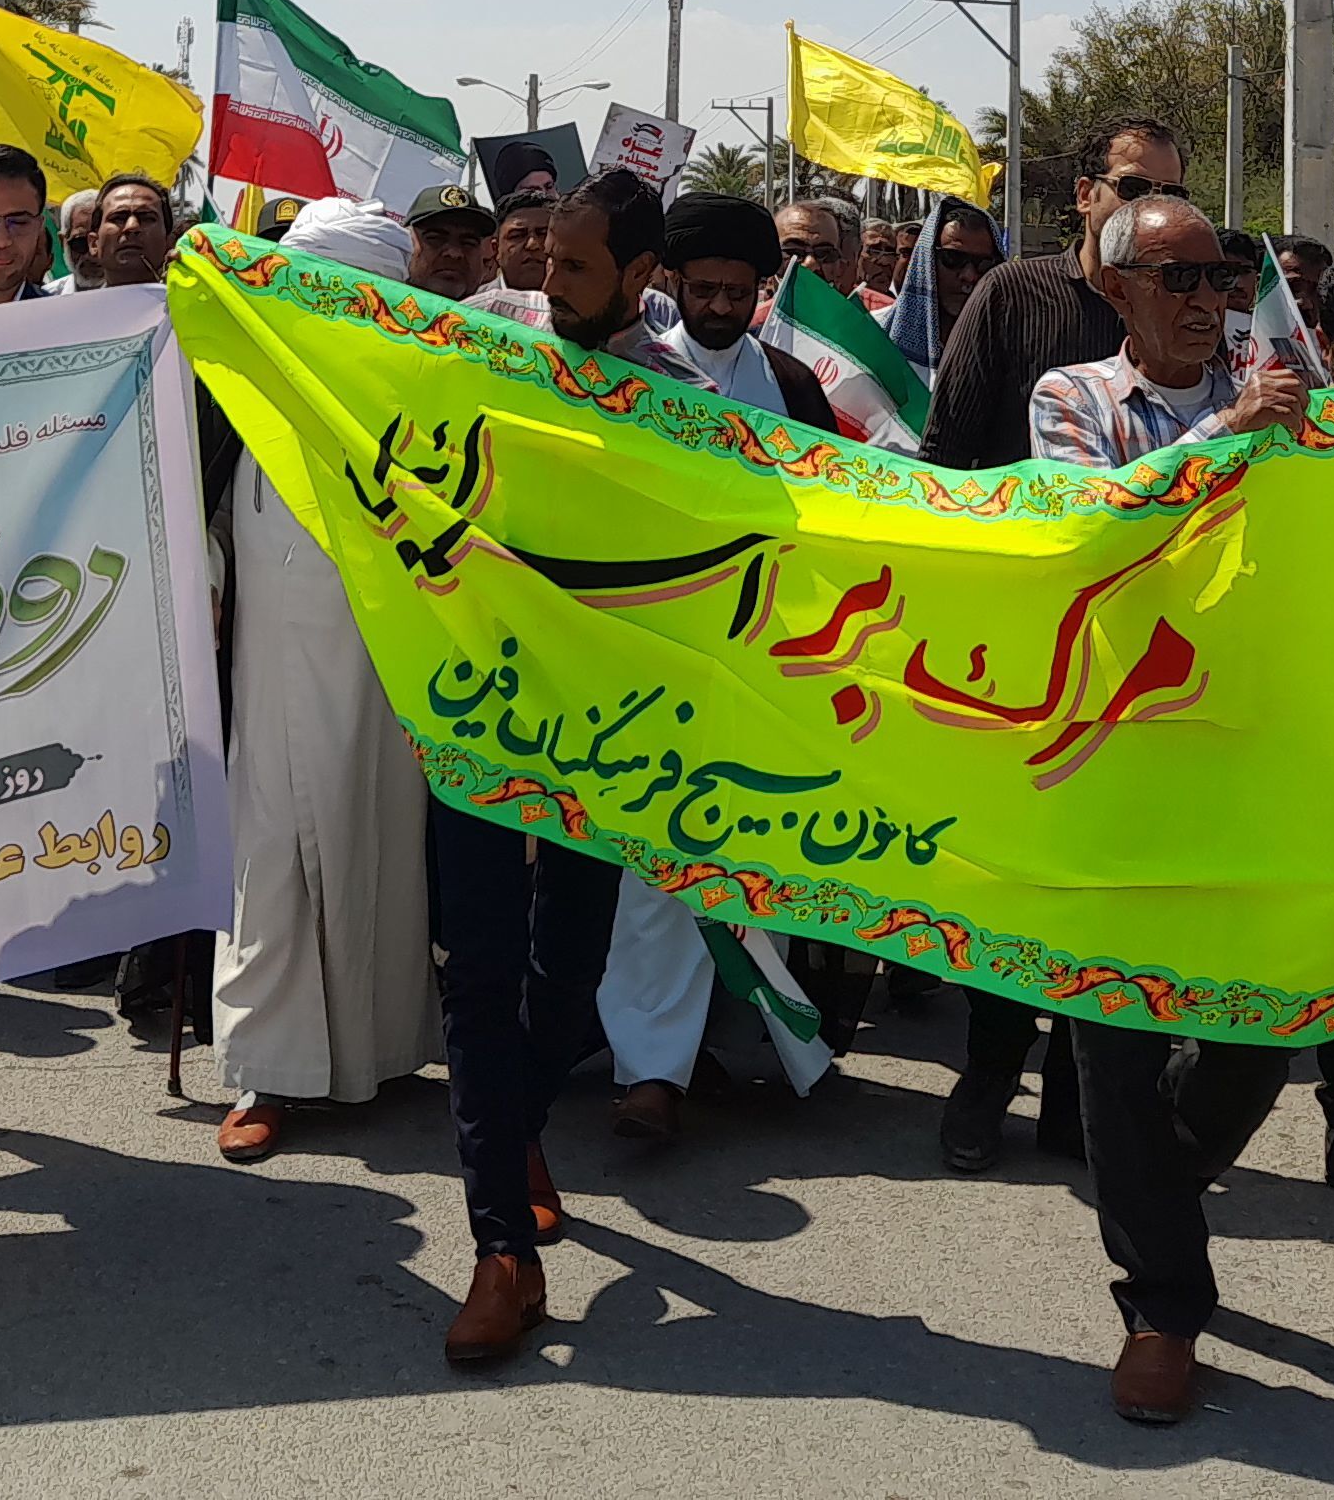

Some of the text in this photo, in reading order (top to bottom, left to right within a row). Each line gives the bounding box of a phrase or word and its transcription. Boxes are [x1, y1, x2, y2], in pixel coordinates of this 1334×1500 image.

[36, 411, 106, 443] مسئله
[768, 564, 891, 726] بر
[0, 764, 45, 800] روز
[668, 760, 842, 857] بسیج
[34, 810, 171, 875] روابط
[799, 805, 958, 866] کانون
